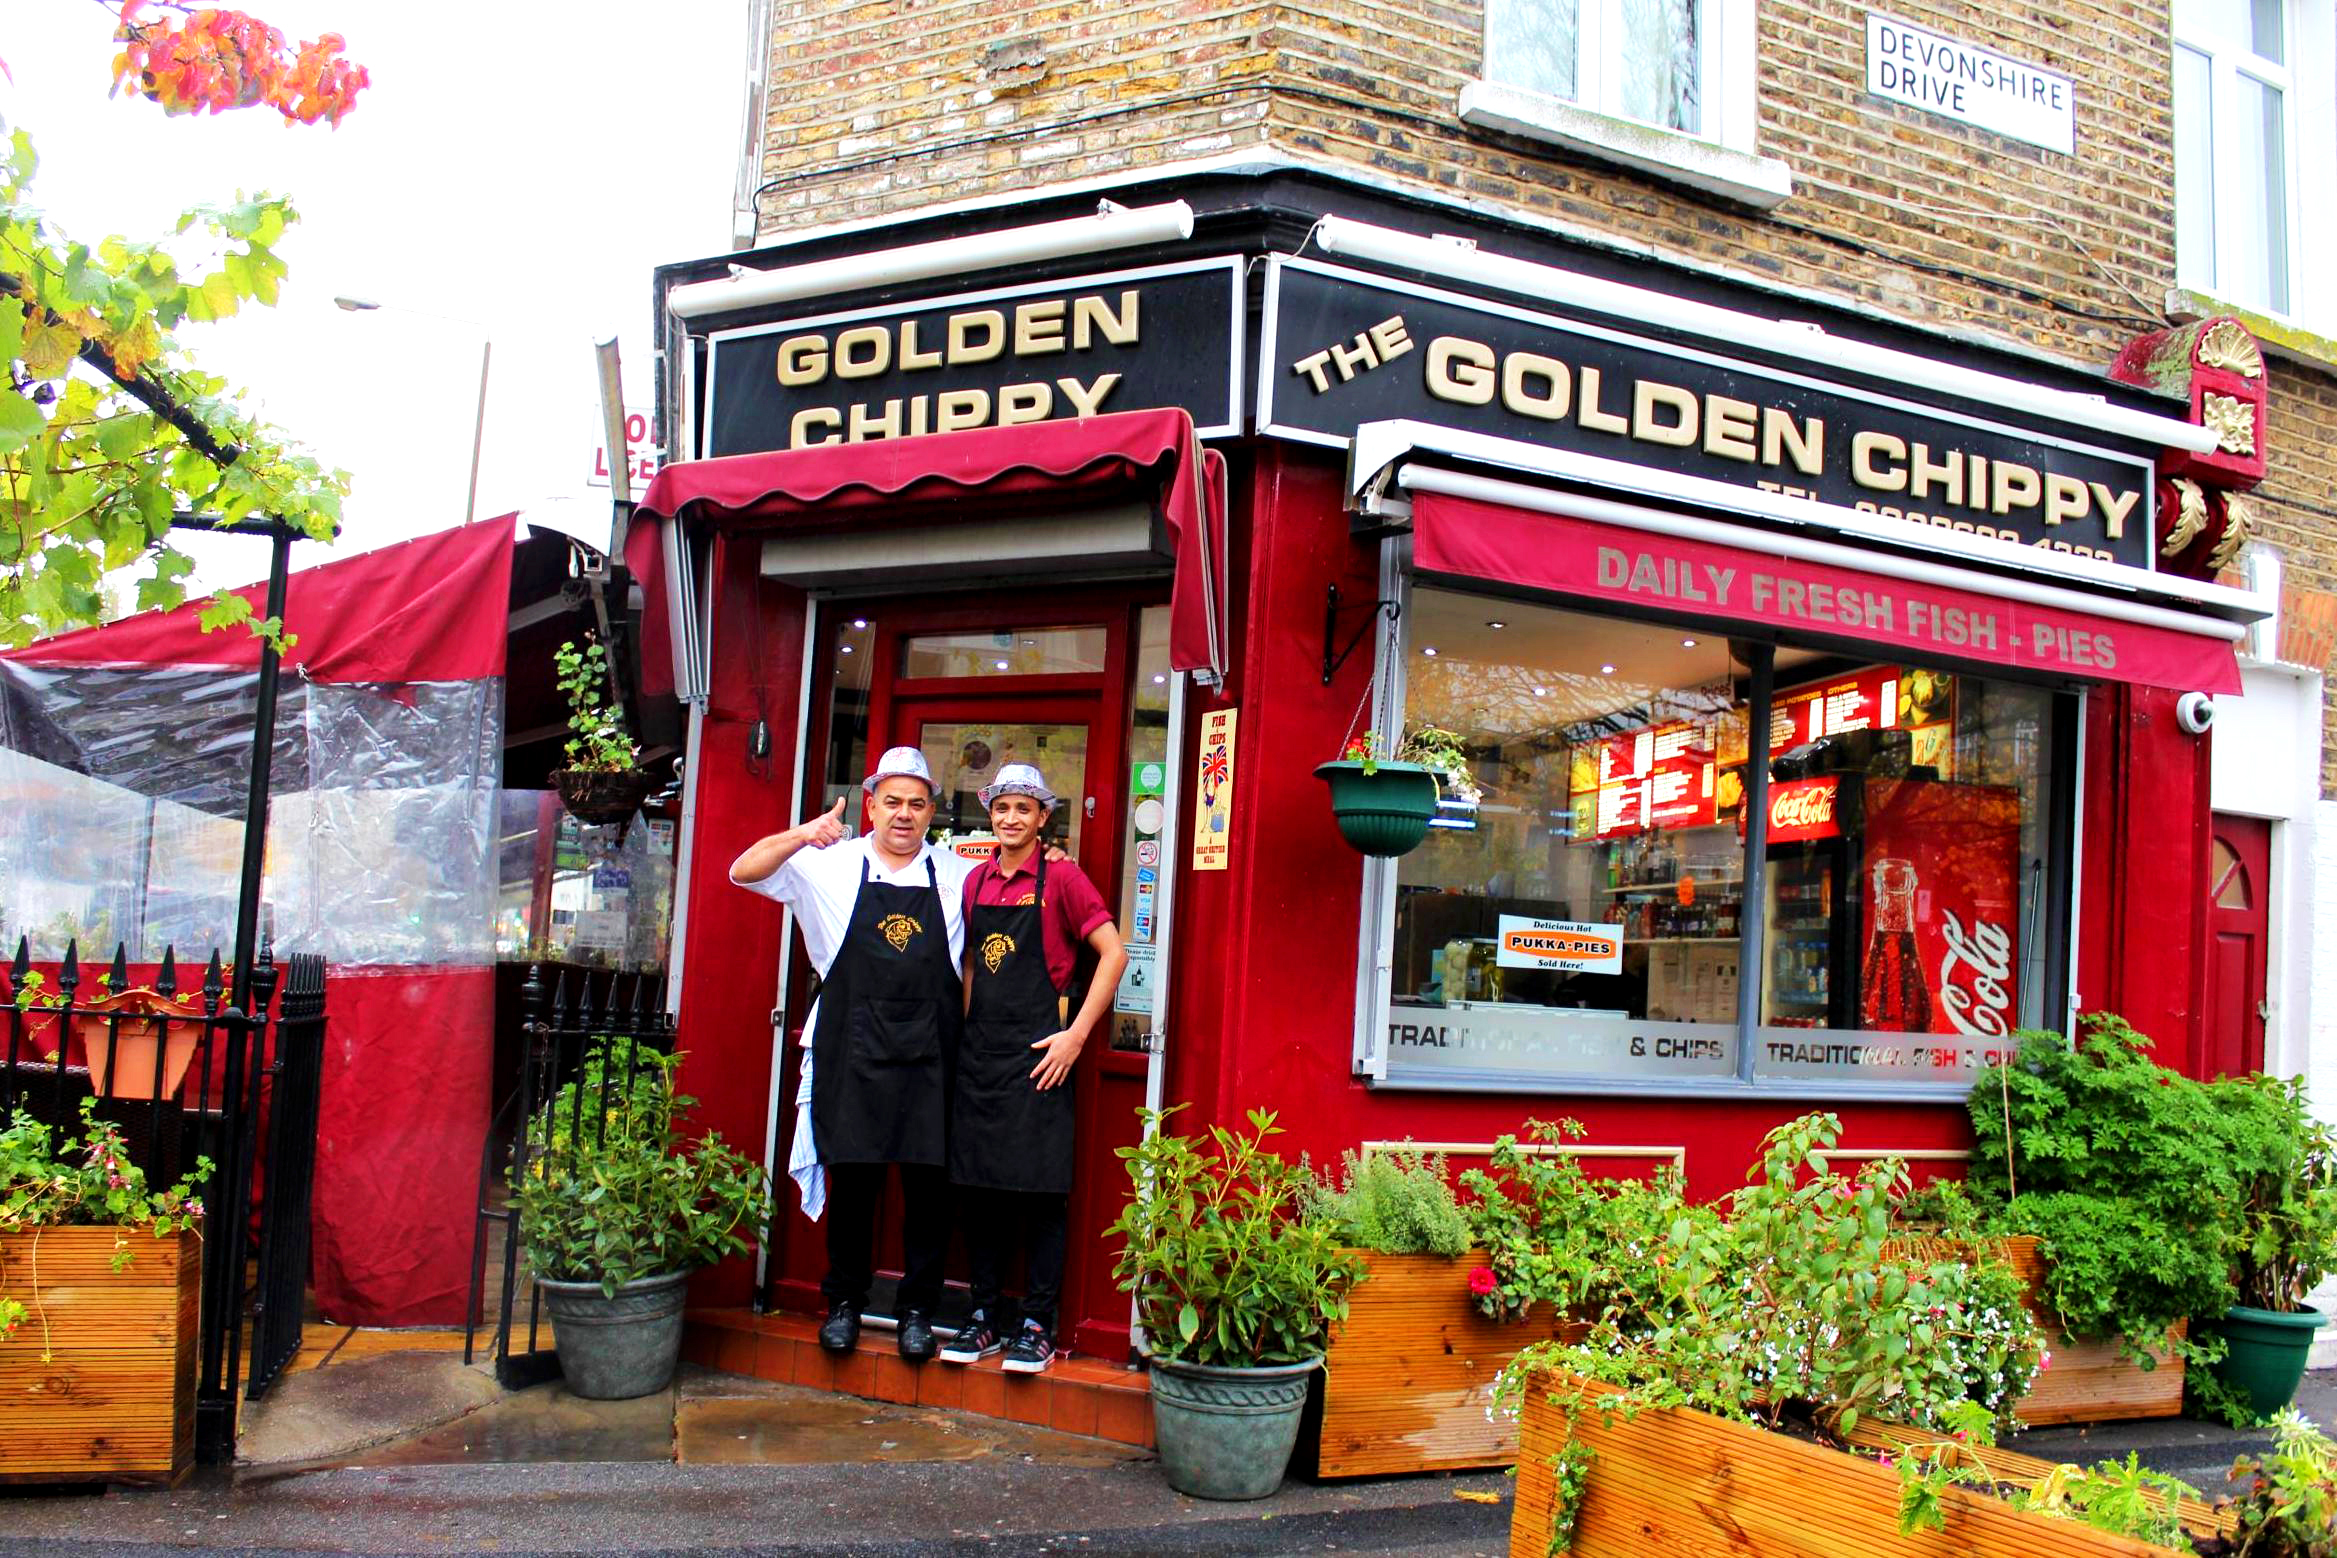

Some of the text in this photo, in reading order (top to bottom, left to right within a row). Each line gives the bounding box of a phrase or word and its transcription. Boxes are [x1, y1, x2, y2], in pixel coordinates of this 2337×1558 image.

[1880, 25, 2063, 110] DEVONSHIRE
[1880, 60, 1965, 113] DRIVE
[777, 290, 1140, 386] GOLDEN
[790, 373, 1122, 450] CHIPPY
[1292, 315, 1415, 394] THE
[1425, 336, 1823, 476] GOLDEN
[1851, 430, 2141, 539] CHIPPY
[1597, 546, 1736, 605] DAILY
[1751, 573, 1894, 632] FRESH
[1907, 600, 1997, 650] FISH
[2032, 622, 2117, 670] PIES
[1533, 920, 1592, 933] Delicious Hot
[1537, 959, 1558, 968] Sold
[1940, 908, 2011, 1038] Cola
[1629, 1036, 1646, 1057] &
[1655, 1037, 1724, 1060] CHIPS
